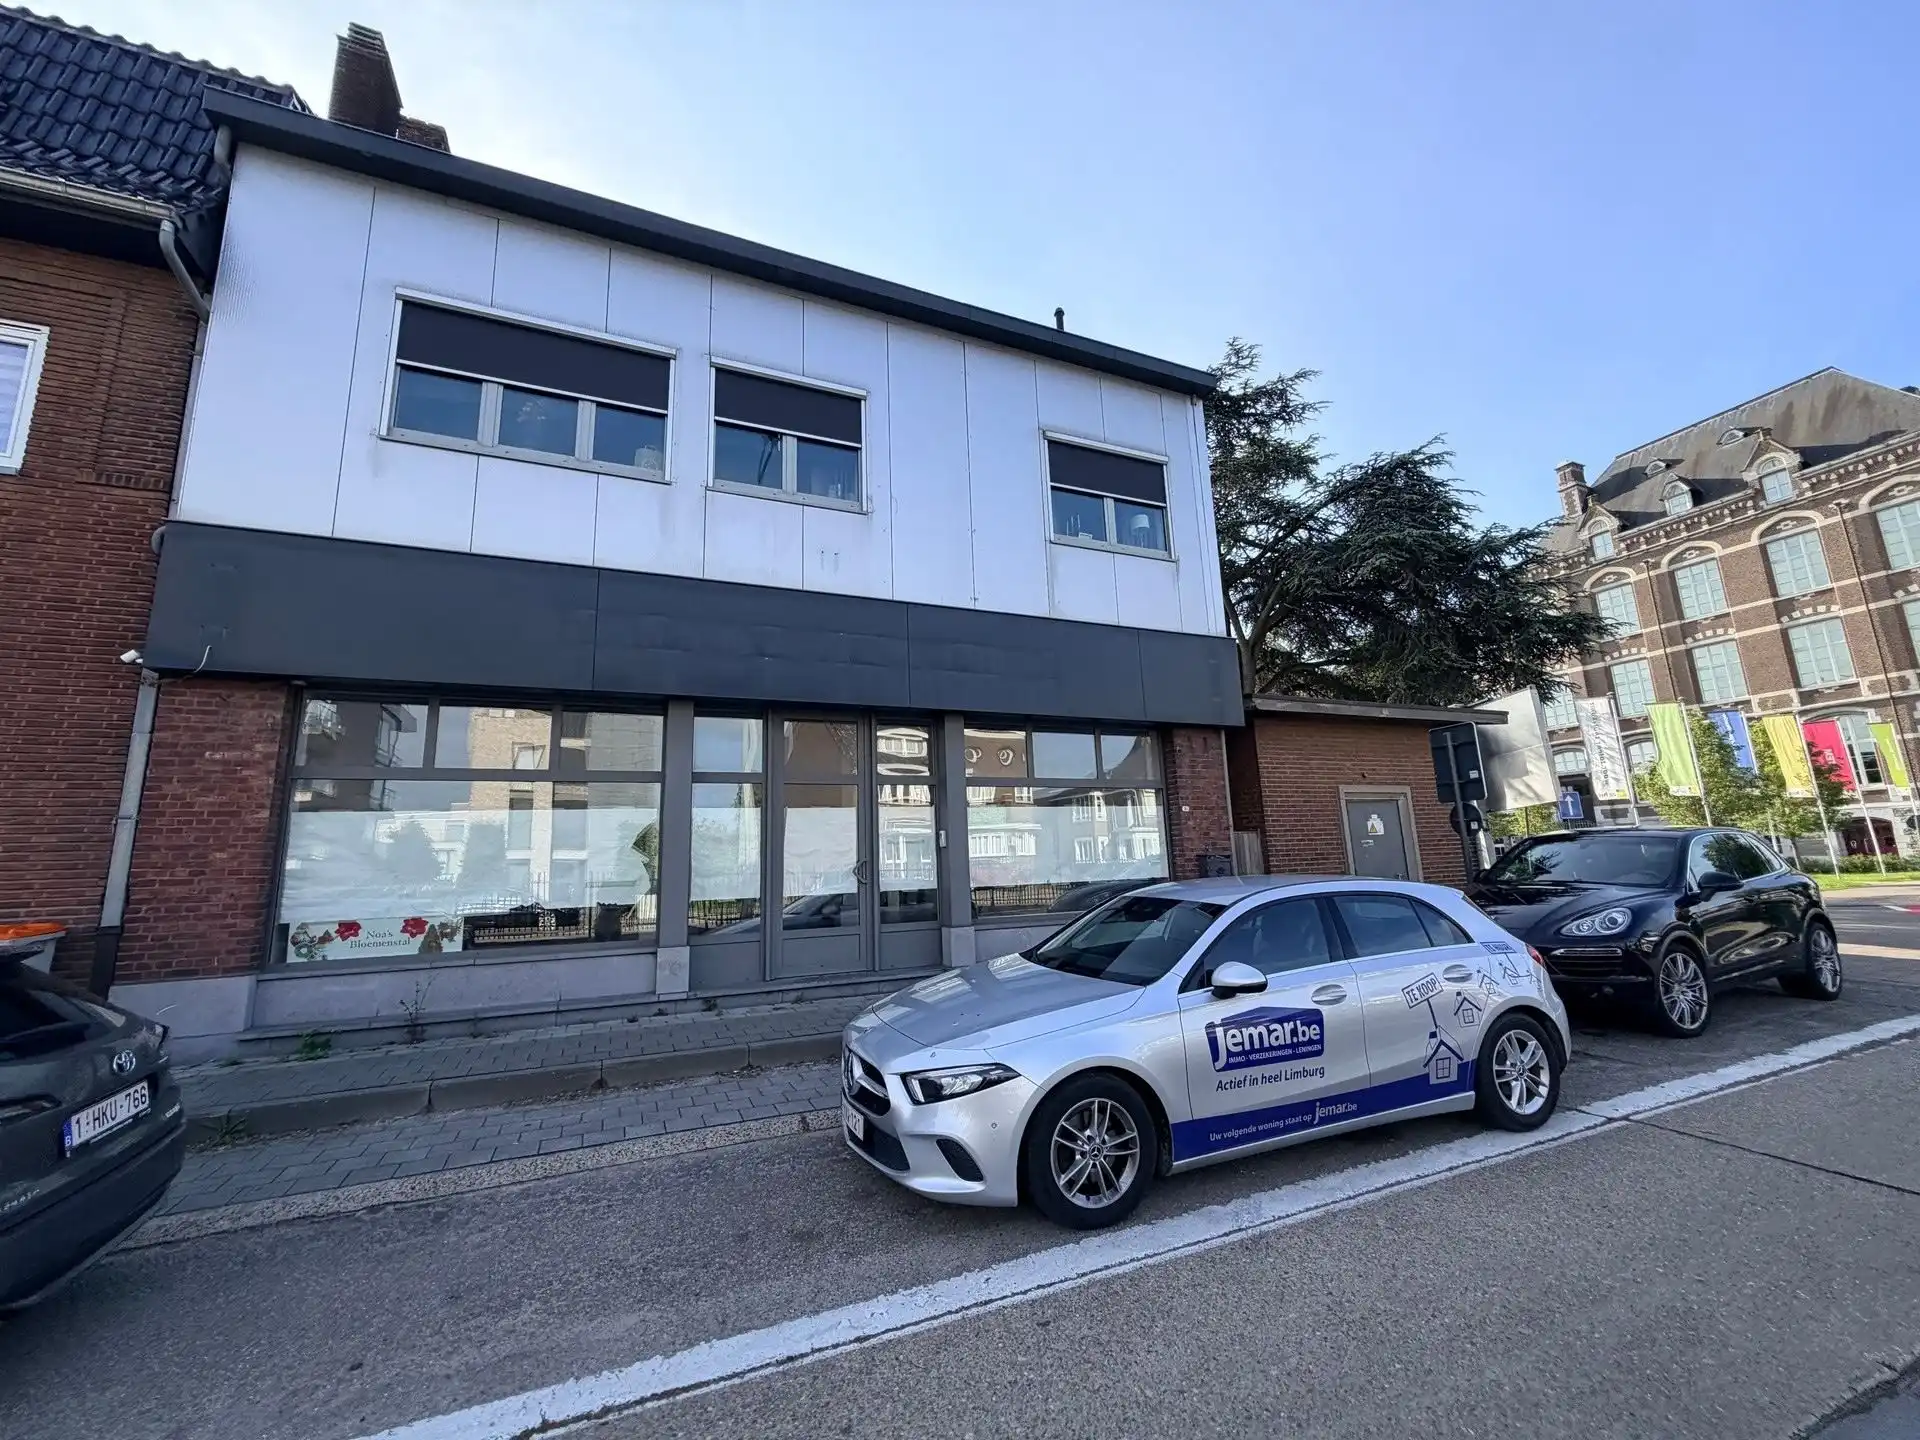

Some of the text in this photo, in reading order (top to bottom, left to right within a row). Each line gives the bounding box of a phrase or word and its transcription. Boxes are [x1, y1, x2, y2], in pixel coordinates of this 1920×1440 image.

[350, 937, 411, 948] Bloemenstal
[366, 929, 393, 940] Noa's
[1406, 978, 1437, 1003] TE KOOP
[1228, 1055, 1246, 1064] IMMO
[1249, 1048, 1293, 1061] VERZEKERINGEN
[1296, 1044, 1322, 1054] LENINGEN
[1216, 1066, 1325, 1092] Actief in heel Limburg
[1210, 1101, 1358, 1142] Uw volgende woning staat op jemar.be
